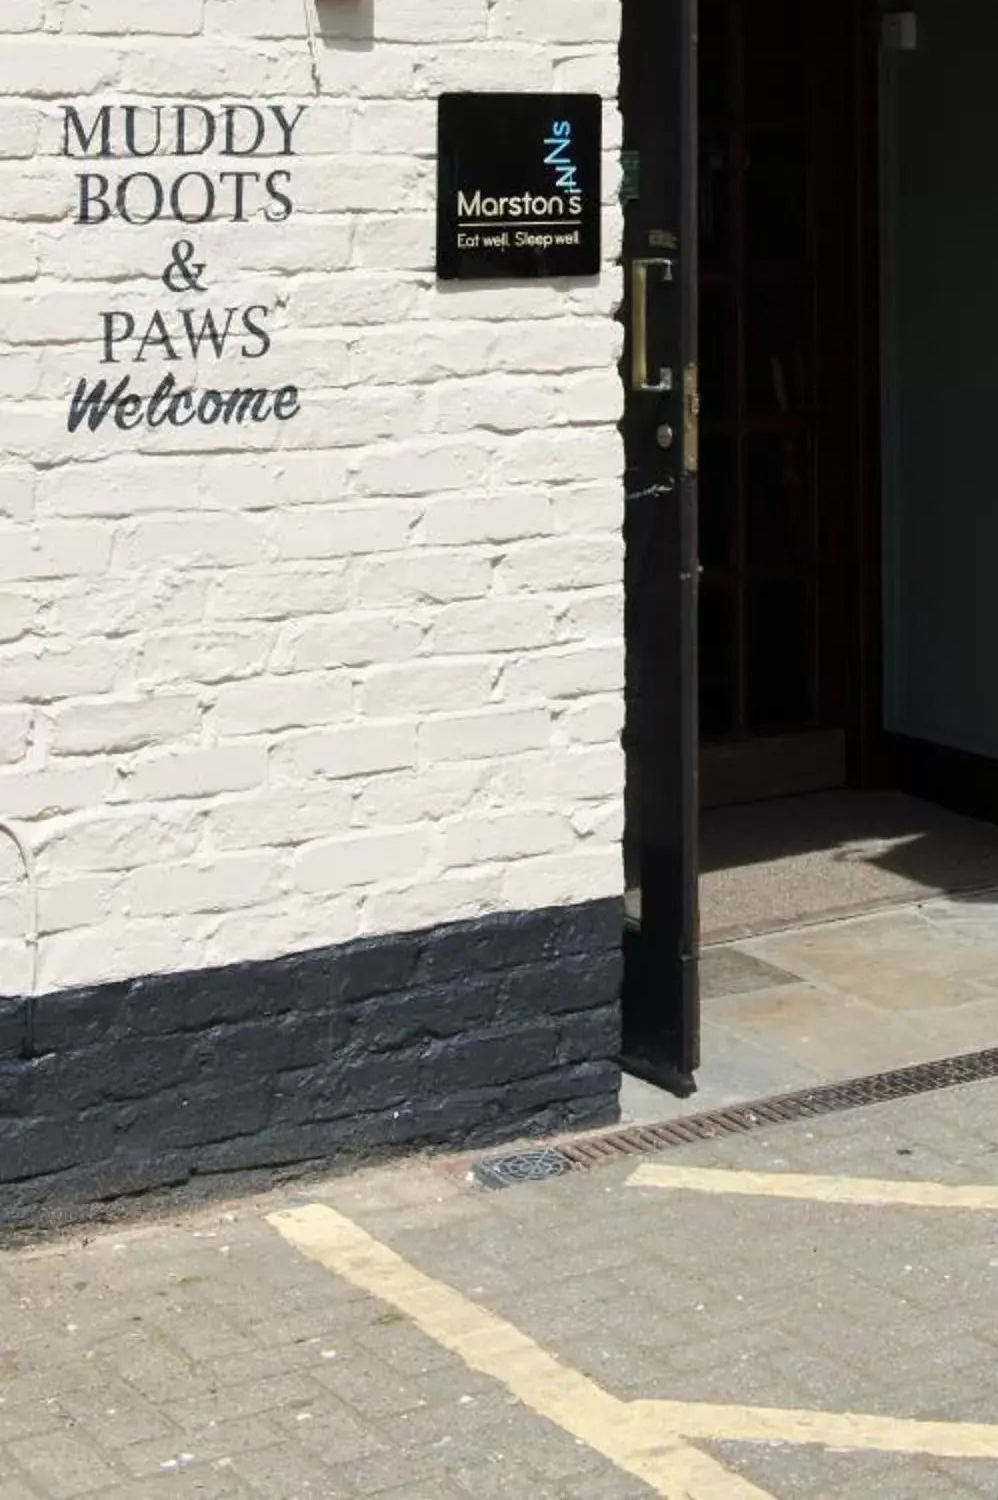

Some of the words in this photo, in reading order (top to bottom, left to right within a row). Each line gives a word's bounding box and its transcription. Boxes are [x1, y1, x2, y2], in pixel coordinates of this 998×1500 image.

[59, 105, 309, 158] MUDDY
[74, 169, 293, 225] BOOTS
[161, 238, 208, 293] &
[457, 233, 479, 249] Eat
[515, 231, 551, 248] Sleep
[99, 305, 272, 364] PAWS
[67, 372, 301, 433] Welcome
